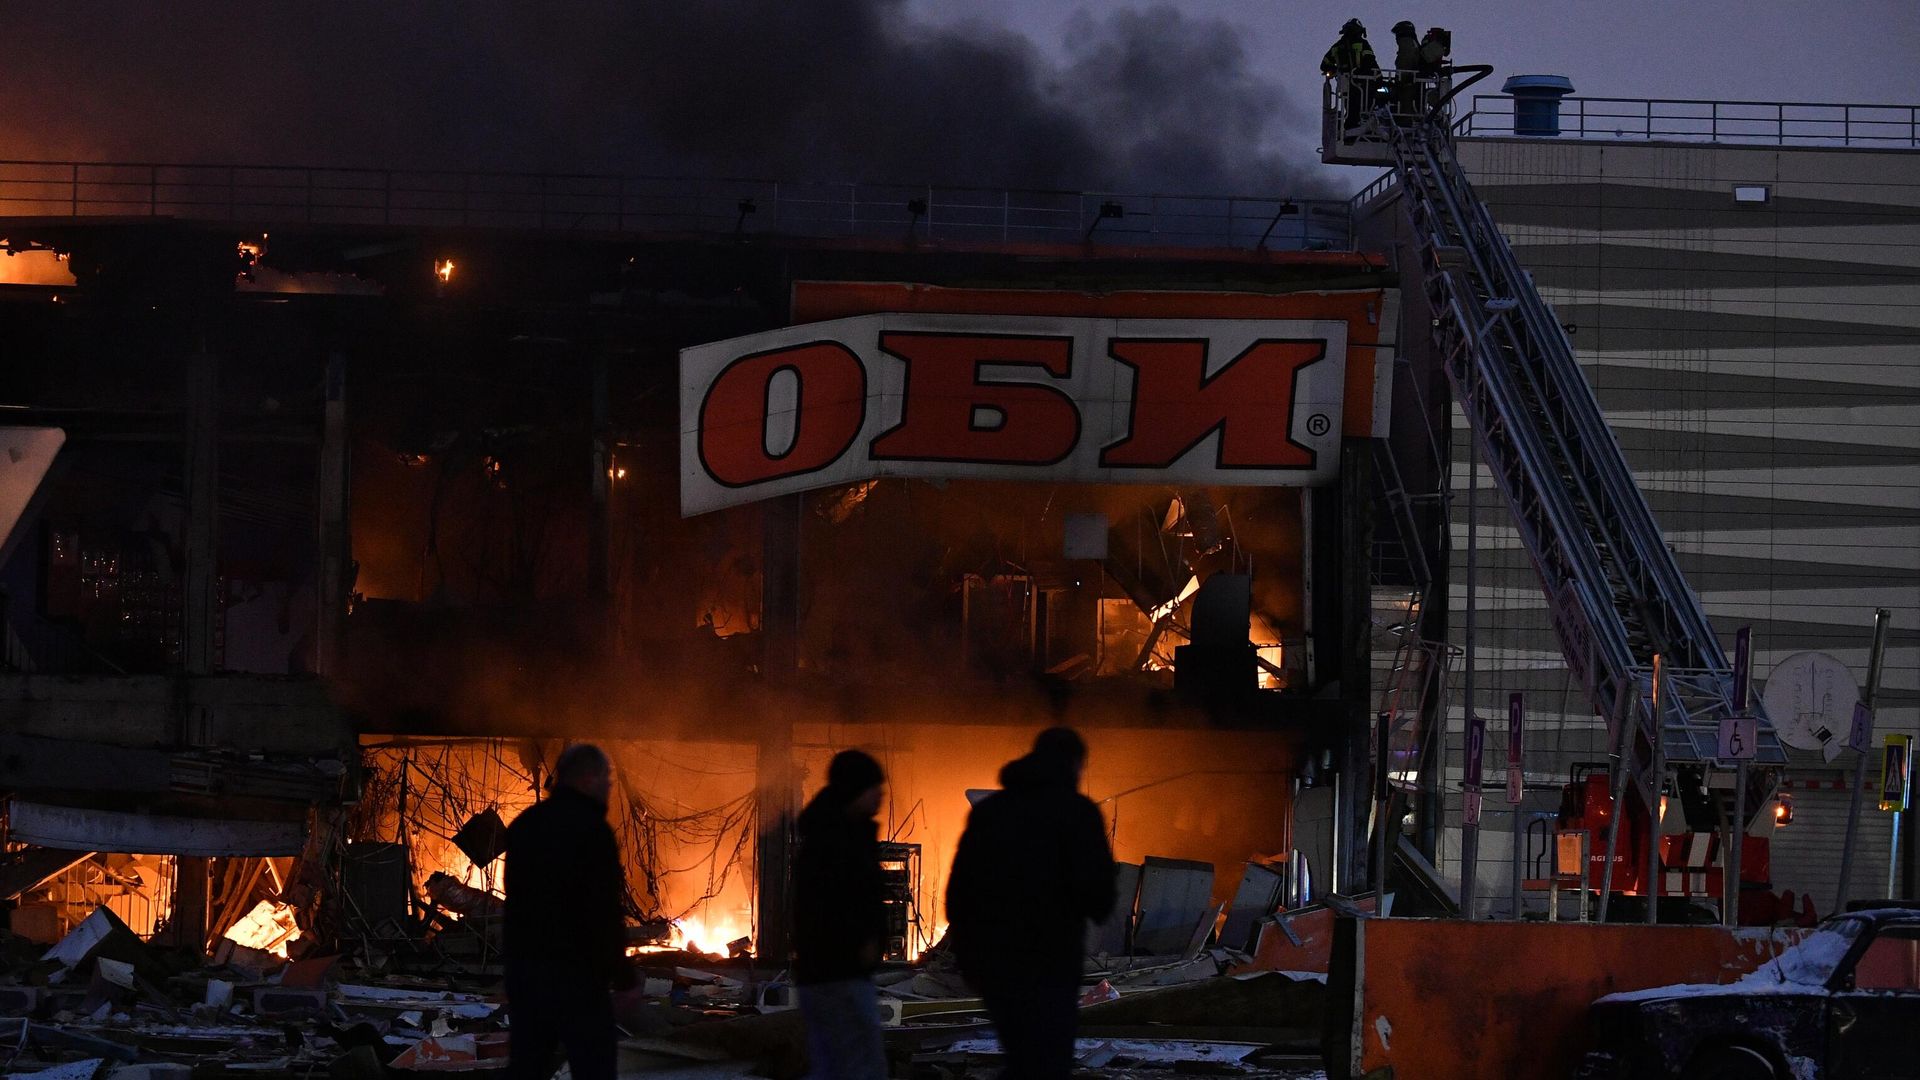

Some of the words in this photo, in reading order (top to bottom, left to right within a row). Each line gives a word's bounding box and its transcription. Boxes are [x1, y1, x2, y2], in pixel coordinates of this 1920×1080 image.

[698, 330, 1327, 487] ОБИ
[1469, 725, 1480, 779] P
[1510, 702, 1520, 757] P
[1588, 855, 1624, 863] AGIUS
